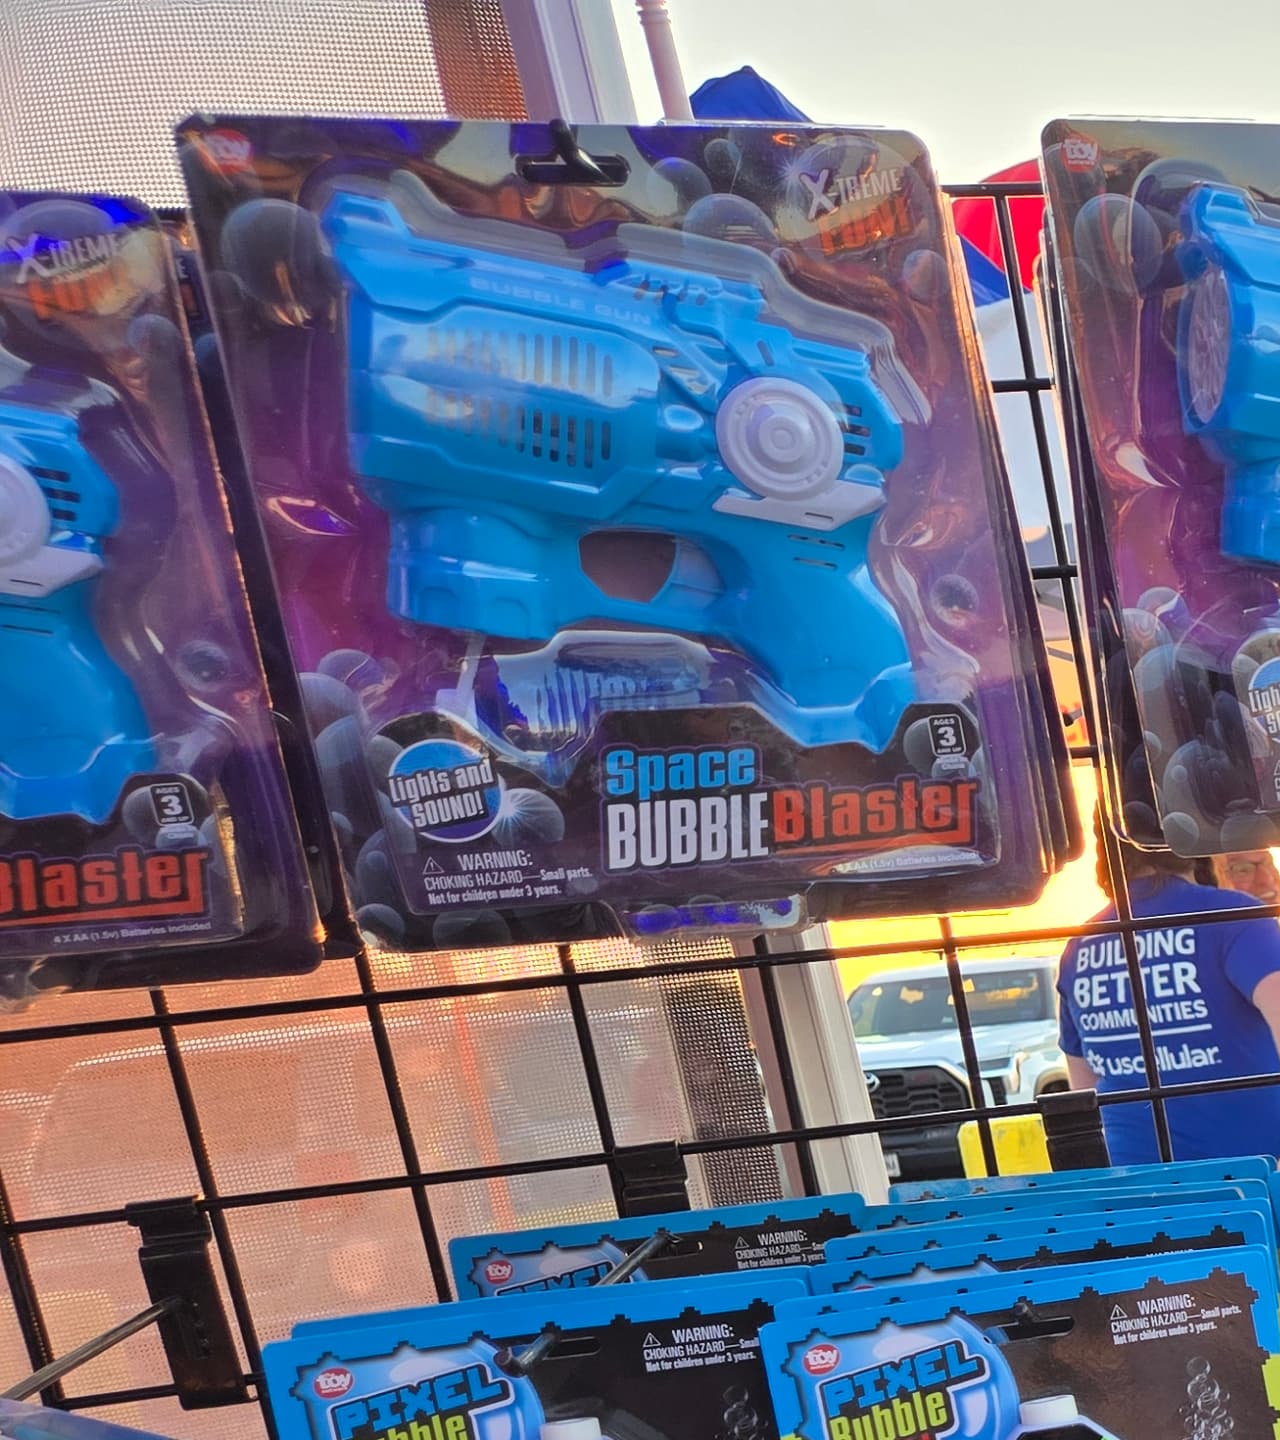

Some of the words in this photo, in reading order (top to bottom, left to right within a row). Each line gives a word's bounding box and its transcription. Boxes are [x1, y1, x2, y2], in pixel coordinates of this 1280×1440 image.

[938, 727, 956, 746] 3
[388, 770, 451, 803] Lights
[455, 757, 494, 787] and
[606, 748, 754, 800] Space
[161, 795, 183, 815] 3
[411, 790, 484, 828] SOUND!
[607, 793, 768, 869] BUBBLE
[772, 780, 977, 843] Blaster
[457, 850, 533, 871] WARNING:
[424, 876, 473, 891] CHOKING
[1137, 1294, 1196, 1314] WARNING:
[672, 1323, 734, 1343] WARNING:
[643, 1347, 685, 1361] CHOKING
[823, 1344, 979, 1417] PIXEL
[335, 1367, 503, 1440] PIXEL
